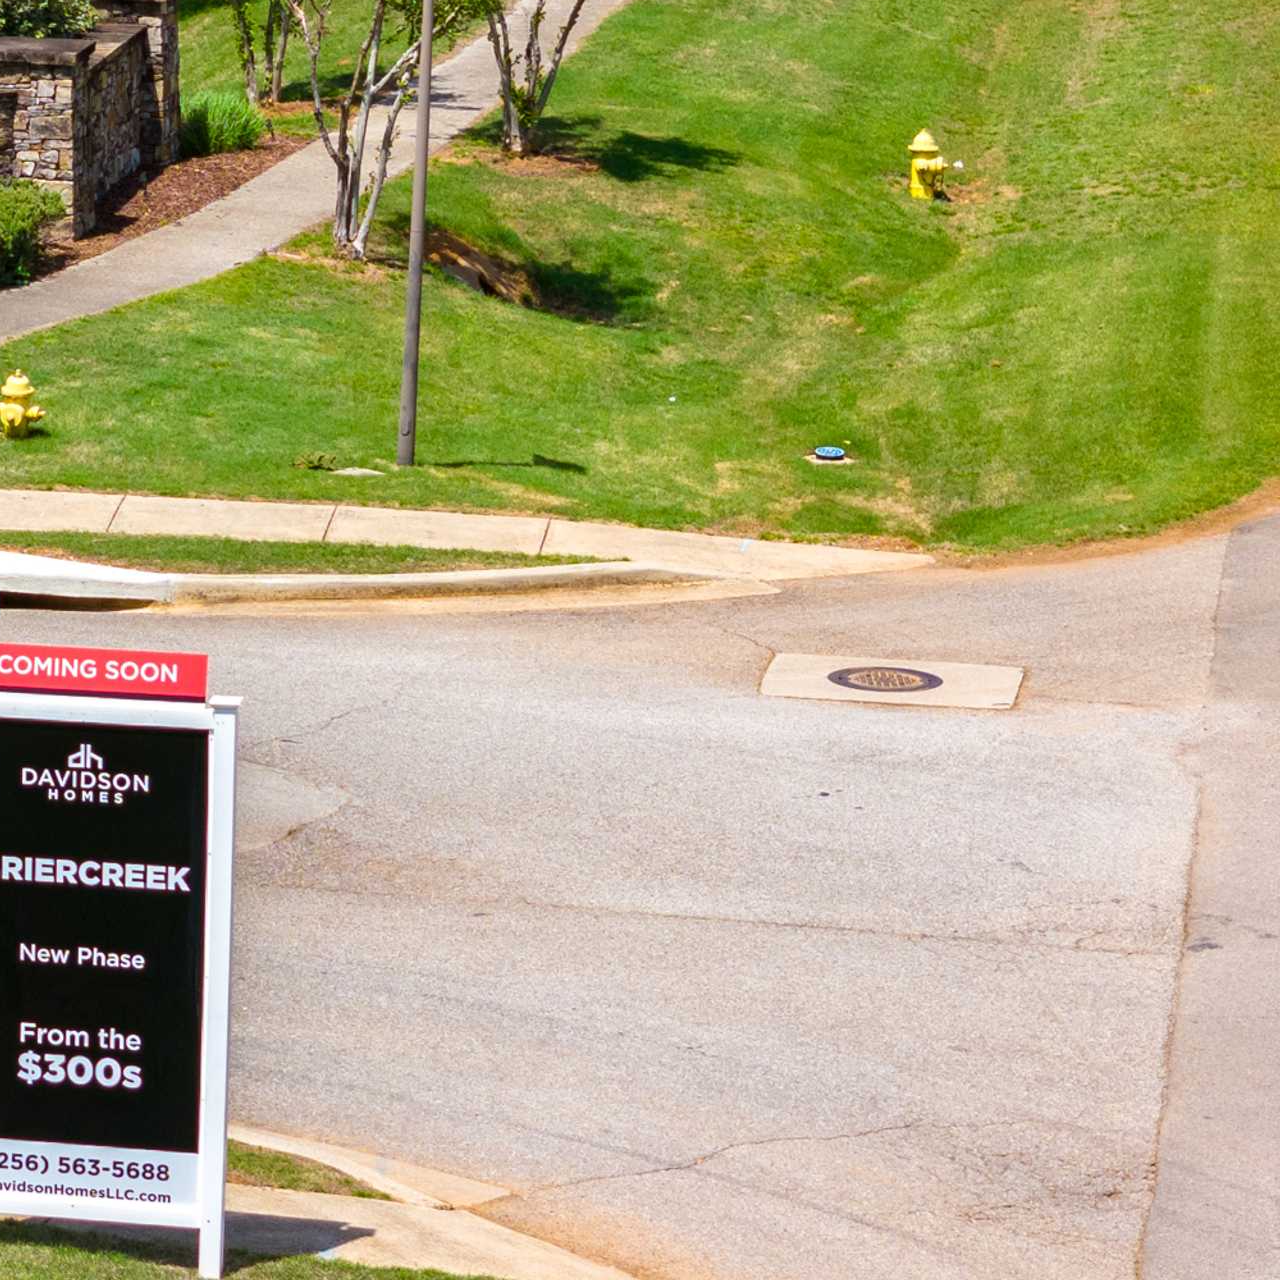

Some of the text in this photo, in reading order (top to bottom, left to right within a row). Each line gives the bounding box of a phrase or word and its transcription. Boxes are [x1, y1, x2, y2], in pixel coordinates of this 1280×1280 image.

[105, 662, 178, 683] SOON
[21, 767, 150, 792] DAVIDSON
[48, 788, 124, 804] HOMES
[19, 942, 146, 970] New Phase
[19, 1022, 142, 1051] From the
[16, 1050, 143, 1089] $300s
[57, 1157, 170, 1181] 563-5688
